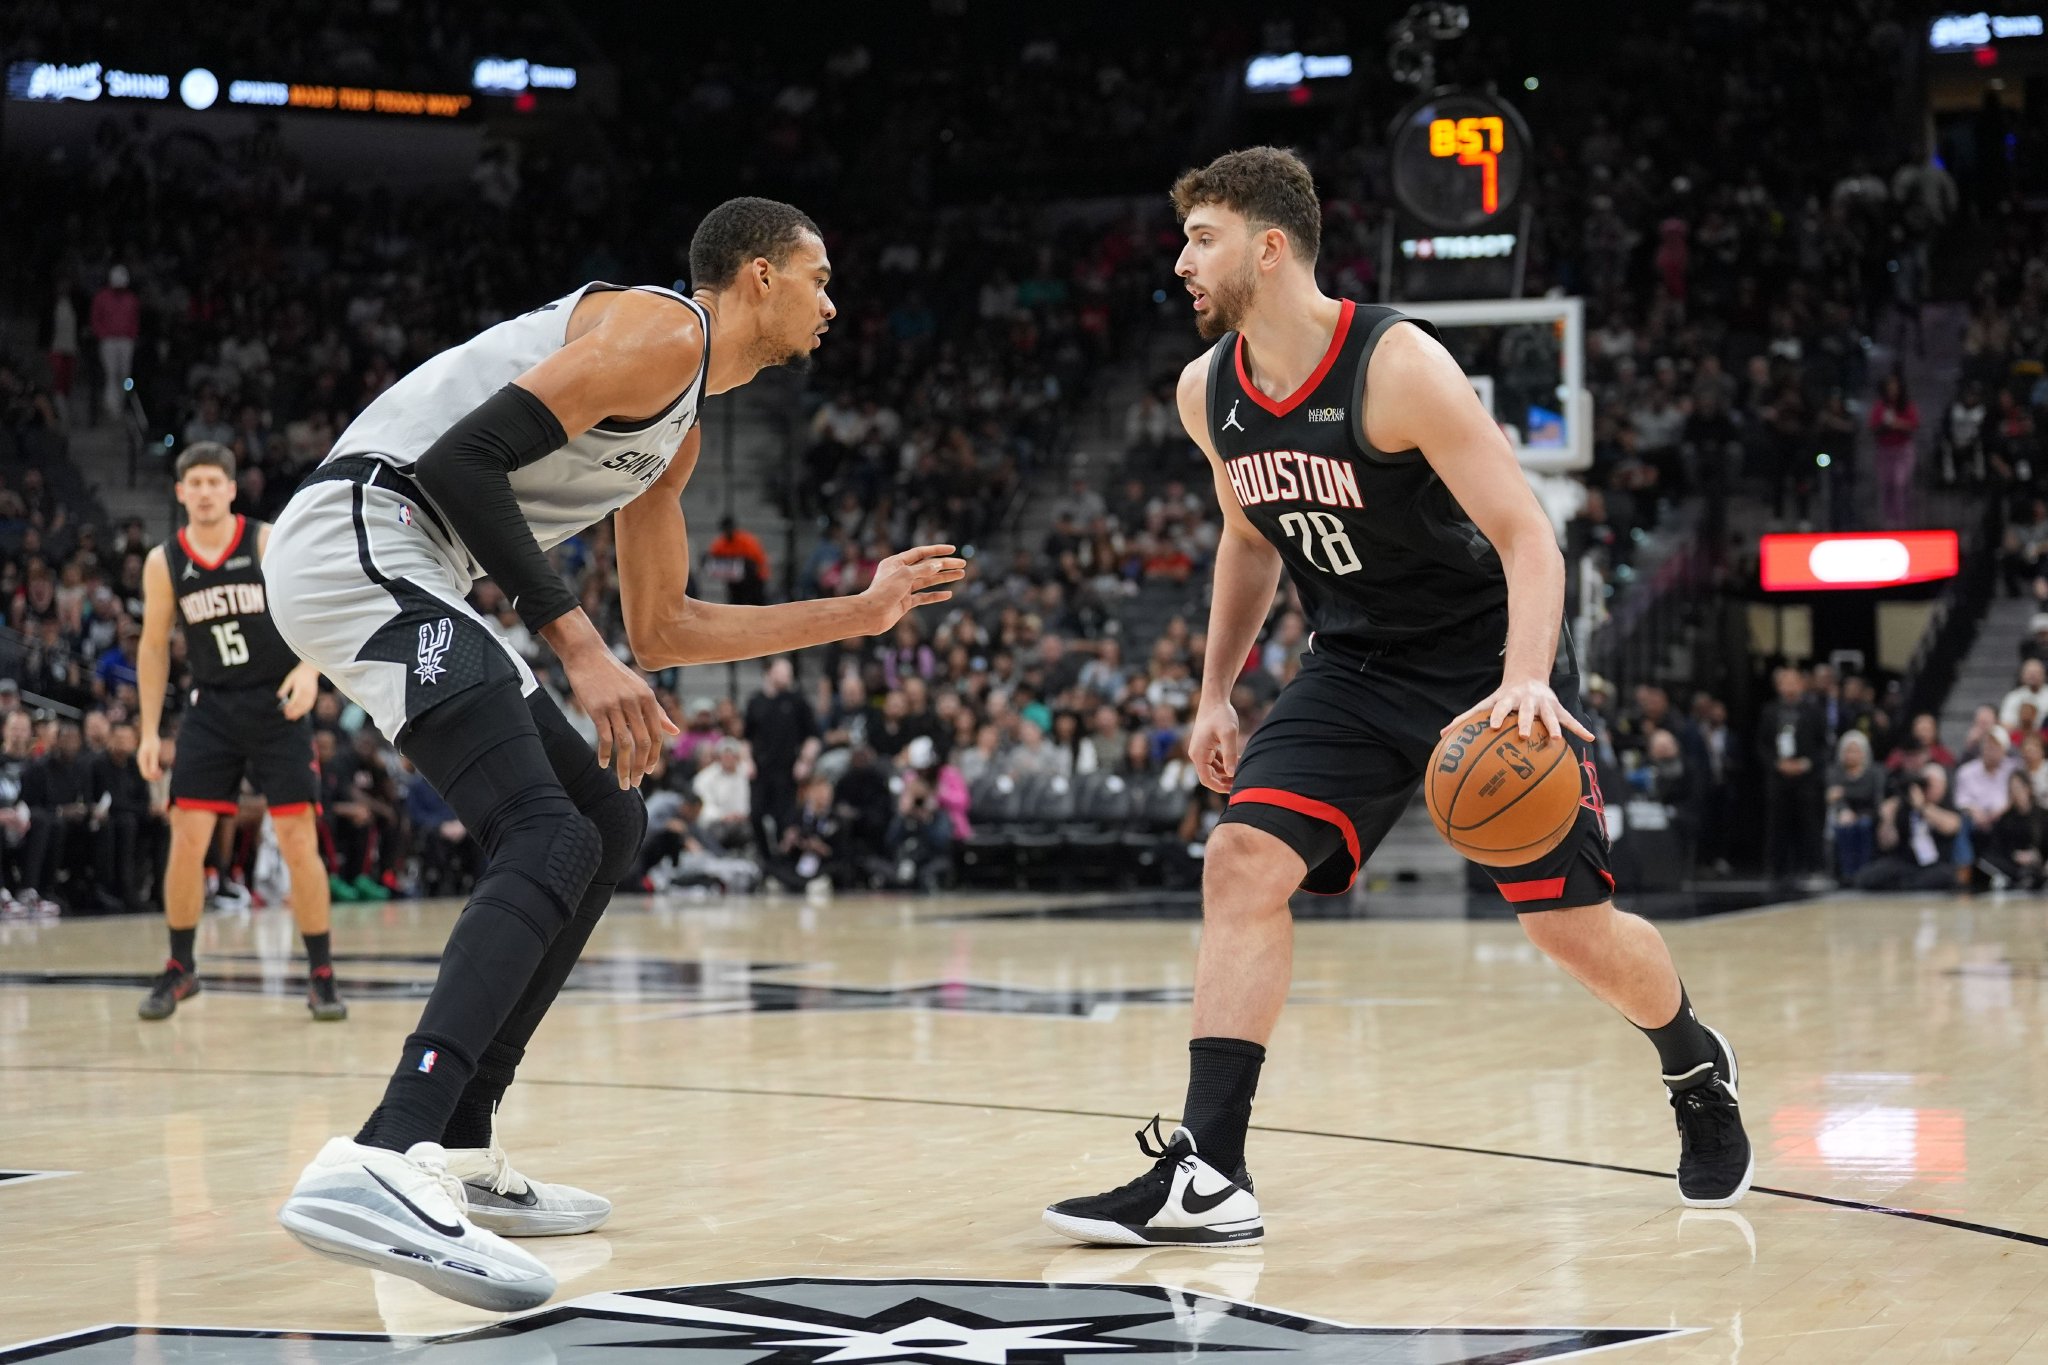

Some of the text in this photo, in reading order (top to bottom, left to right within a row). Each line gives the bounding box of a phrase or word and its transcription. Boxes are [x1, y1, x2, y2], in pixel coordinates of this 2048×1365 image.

[1308, 413, 1345, 422] HERMANN
[1225, 450, 1364, 508] HOUSTON
[179, 583, 265, 625] HOUSTON
[210, 620, 250, 666] 15
